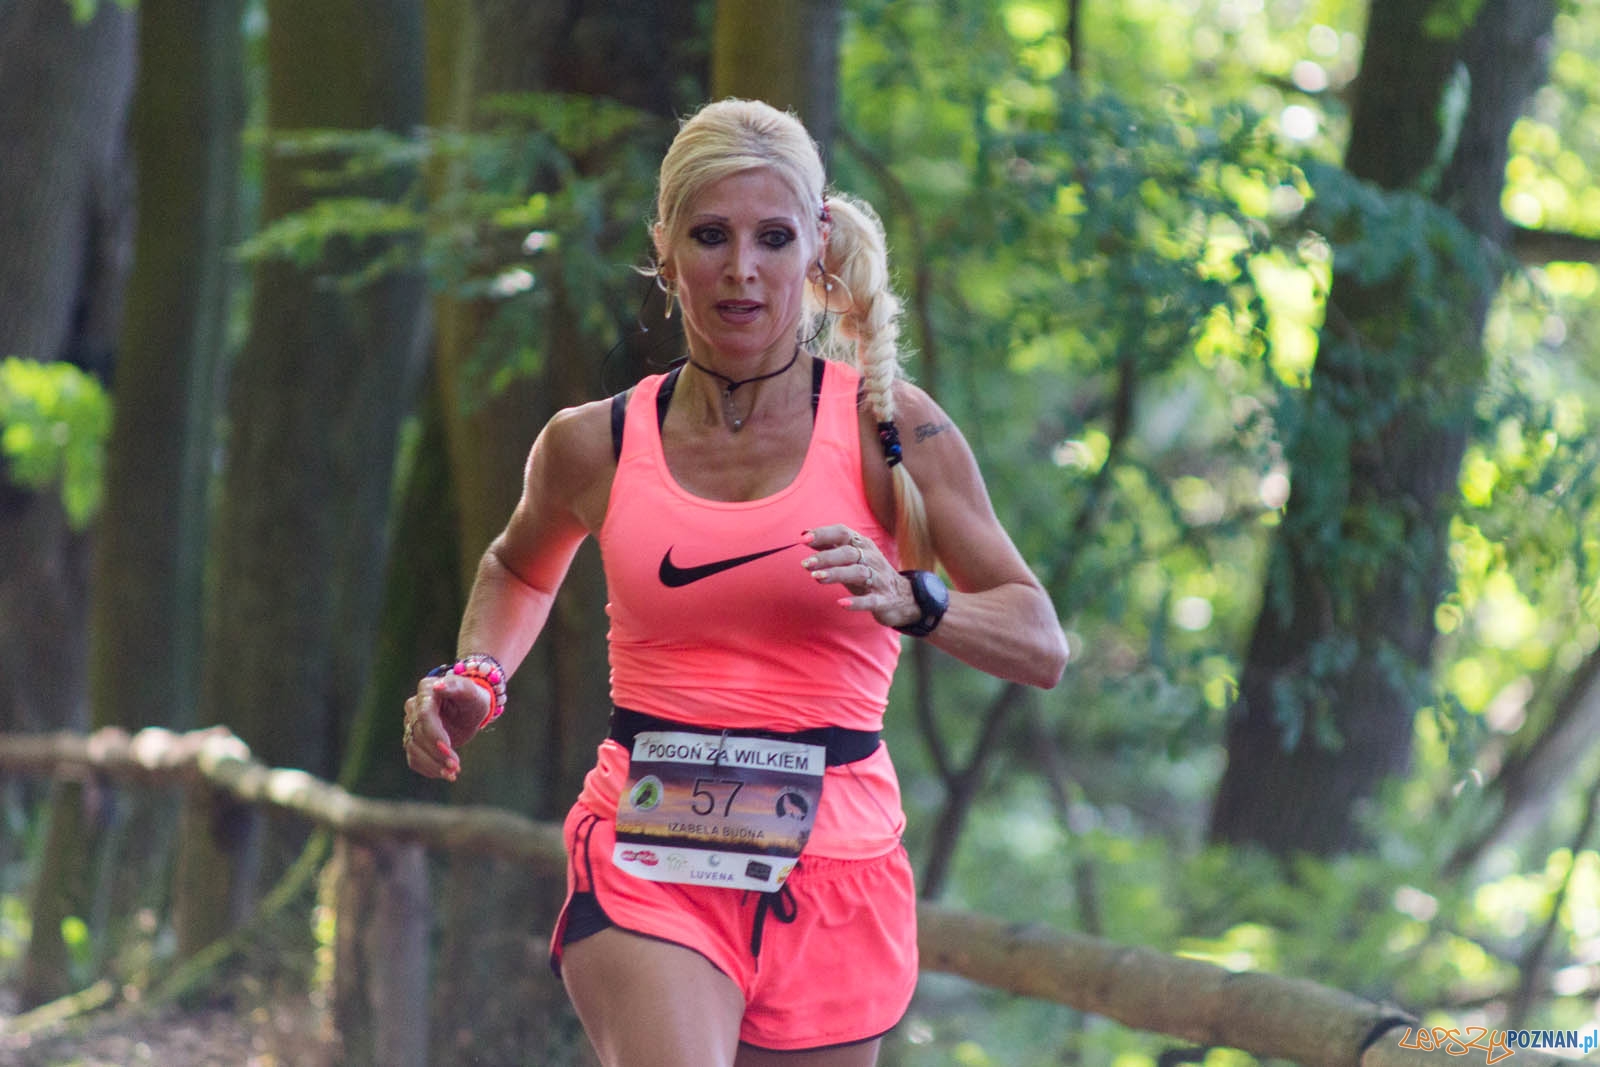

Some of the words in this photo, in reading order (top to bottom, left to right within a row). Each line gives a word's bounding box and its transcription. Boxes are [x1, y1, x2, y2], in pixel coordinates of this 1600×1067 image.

[648, 742, 702, 759] POGOŃ
[706, 748, 728, 762] ZA
[735, 750, 808, 770] WILKIEM
[691, 779, 744, 817] 57
[668, 823, 718, 834] IZABELA
[690, 870, 734, 881] LUVENA
